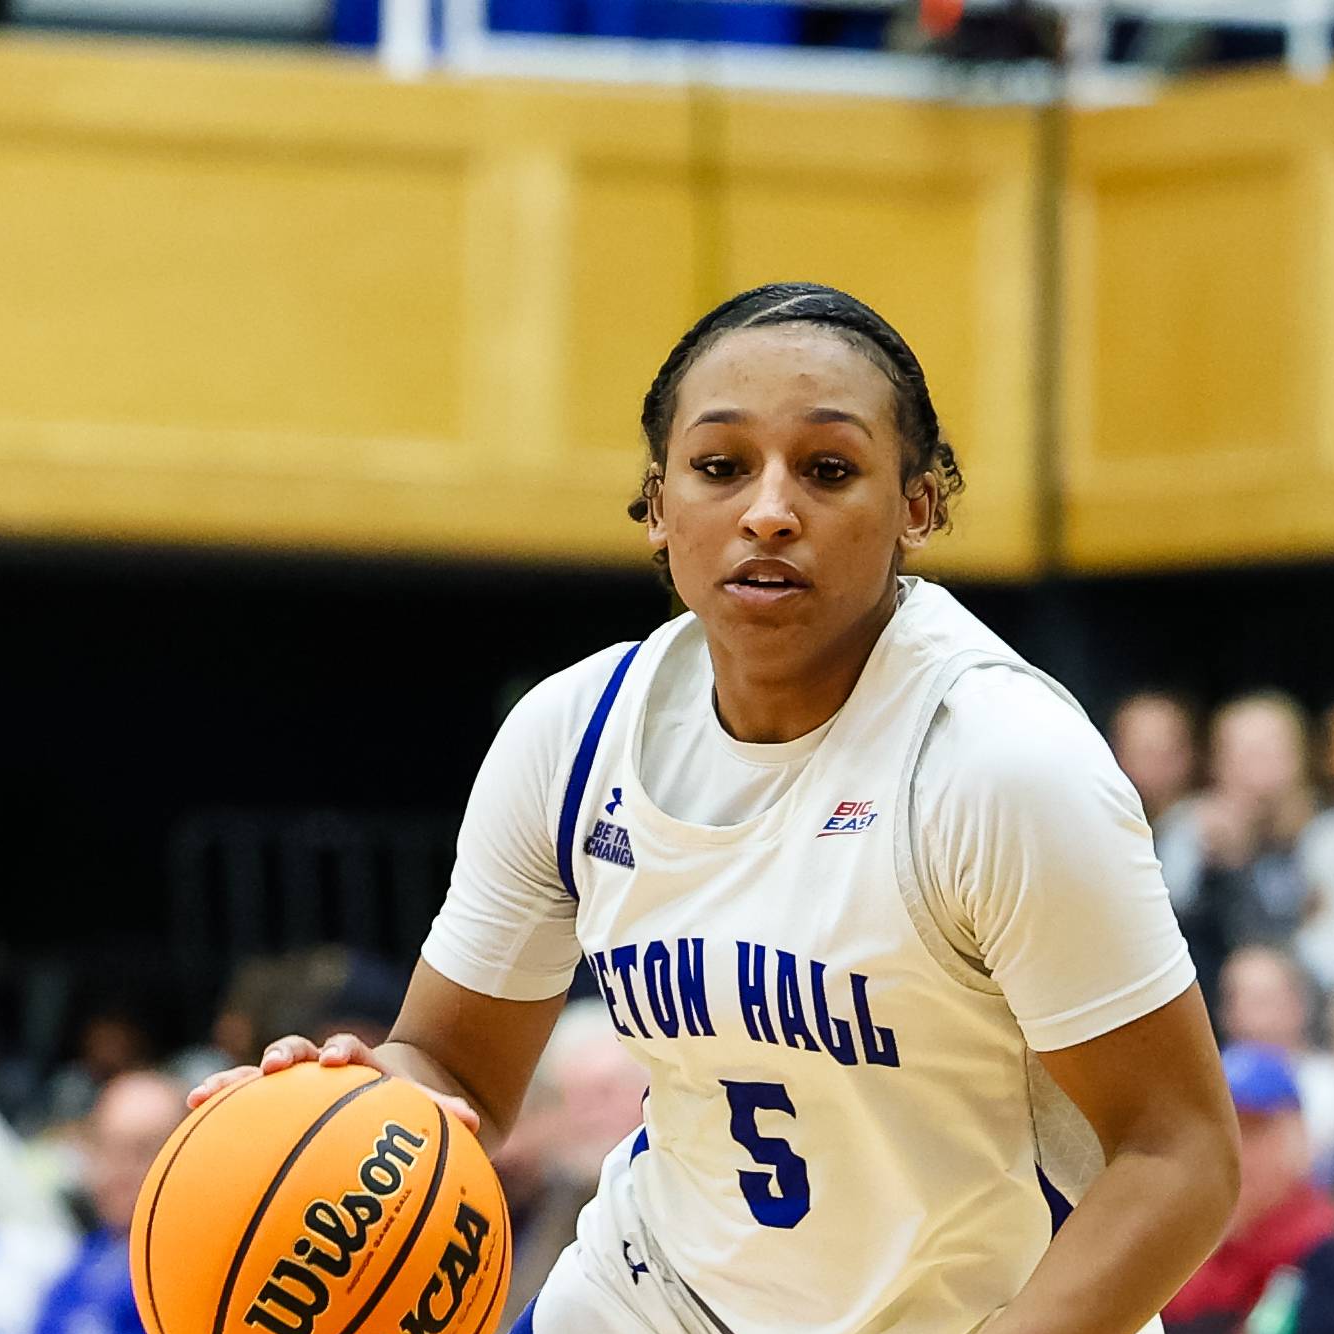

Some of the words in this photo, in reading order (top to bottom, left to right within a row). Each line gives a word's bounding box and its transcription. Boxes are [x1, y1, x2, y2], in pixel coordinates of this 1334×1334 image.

[833, 801, 874, 816] BIG
[593, 818, 615, 841] BE
[823, 813, 878, 831] EAST
[588, 938, 717, 1040] ETON
[735, 940, 900, 1068] HALL
[718, 1079, 811, 1230] 5
